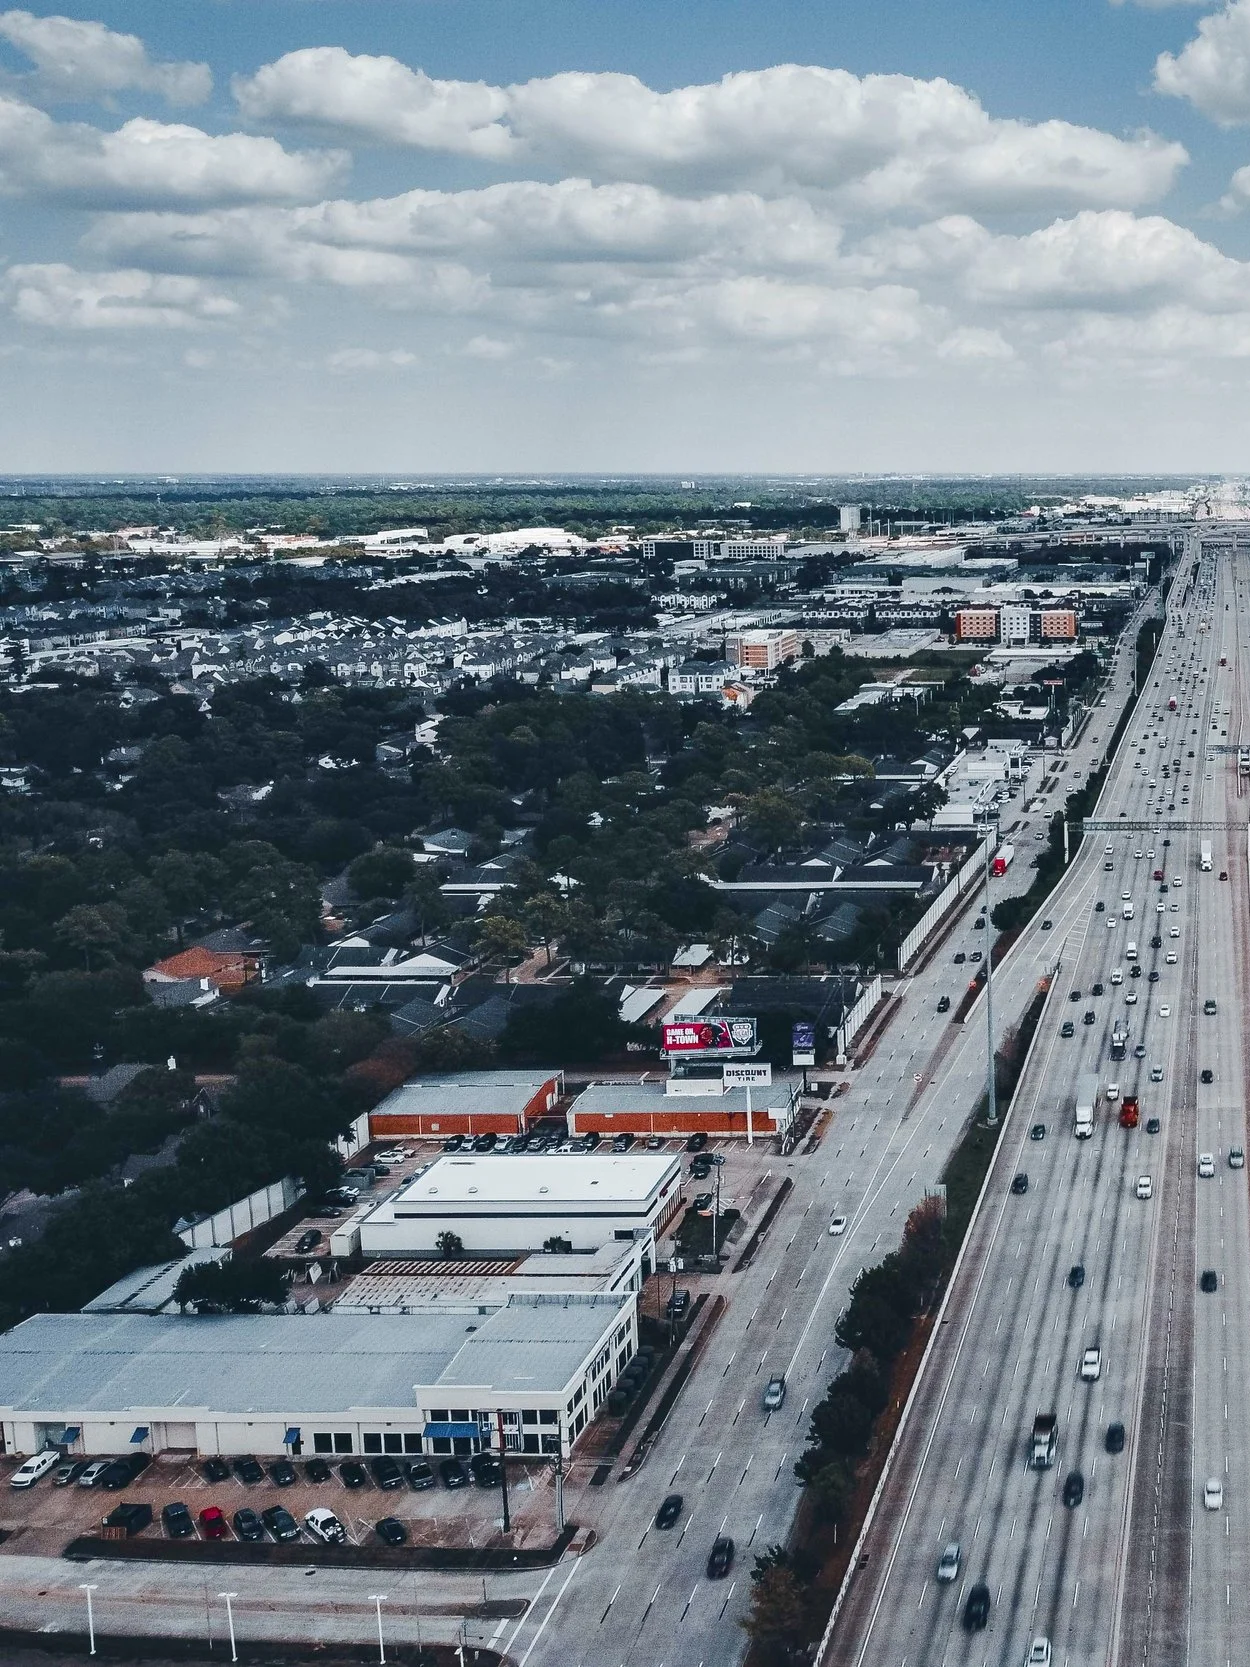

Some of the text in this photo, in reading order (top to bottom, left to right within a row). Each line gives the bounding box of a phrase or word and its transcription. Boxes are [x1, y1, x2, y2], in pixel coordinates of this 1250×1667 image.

[666, 1028, 684, 1036] GAME
[666, 1035, 699, 1045] H-TOWN
[725, 1069, 767, 1077] DISCOUNT
